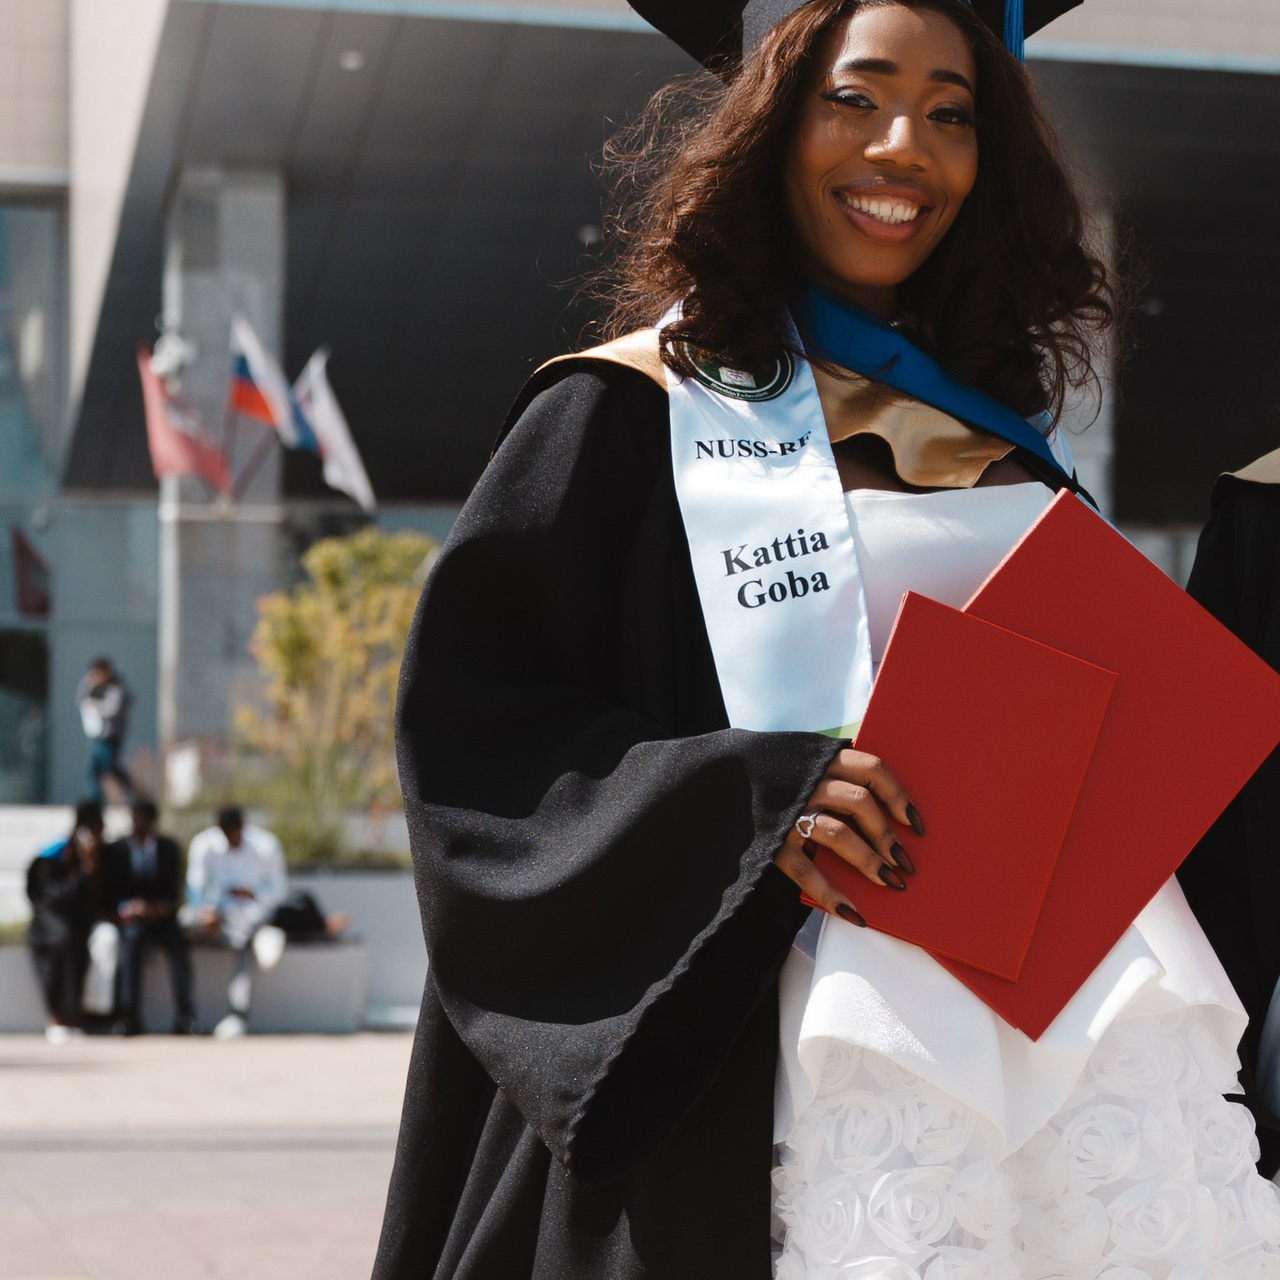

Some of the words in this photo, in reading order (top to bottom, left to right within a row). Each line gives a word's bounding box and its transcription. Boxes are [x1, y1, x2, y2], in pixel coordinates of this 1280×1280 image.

[695, 430, 812, 460] NUSS-RF
[721, 528, 831, 577] Kattia
[736, 568, 831, 609] Goba
